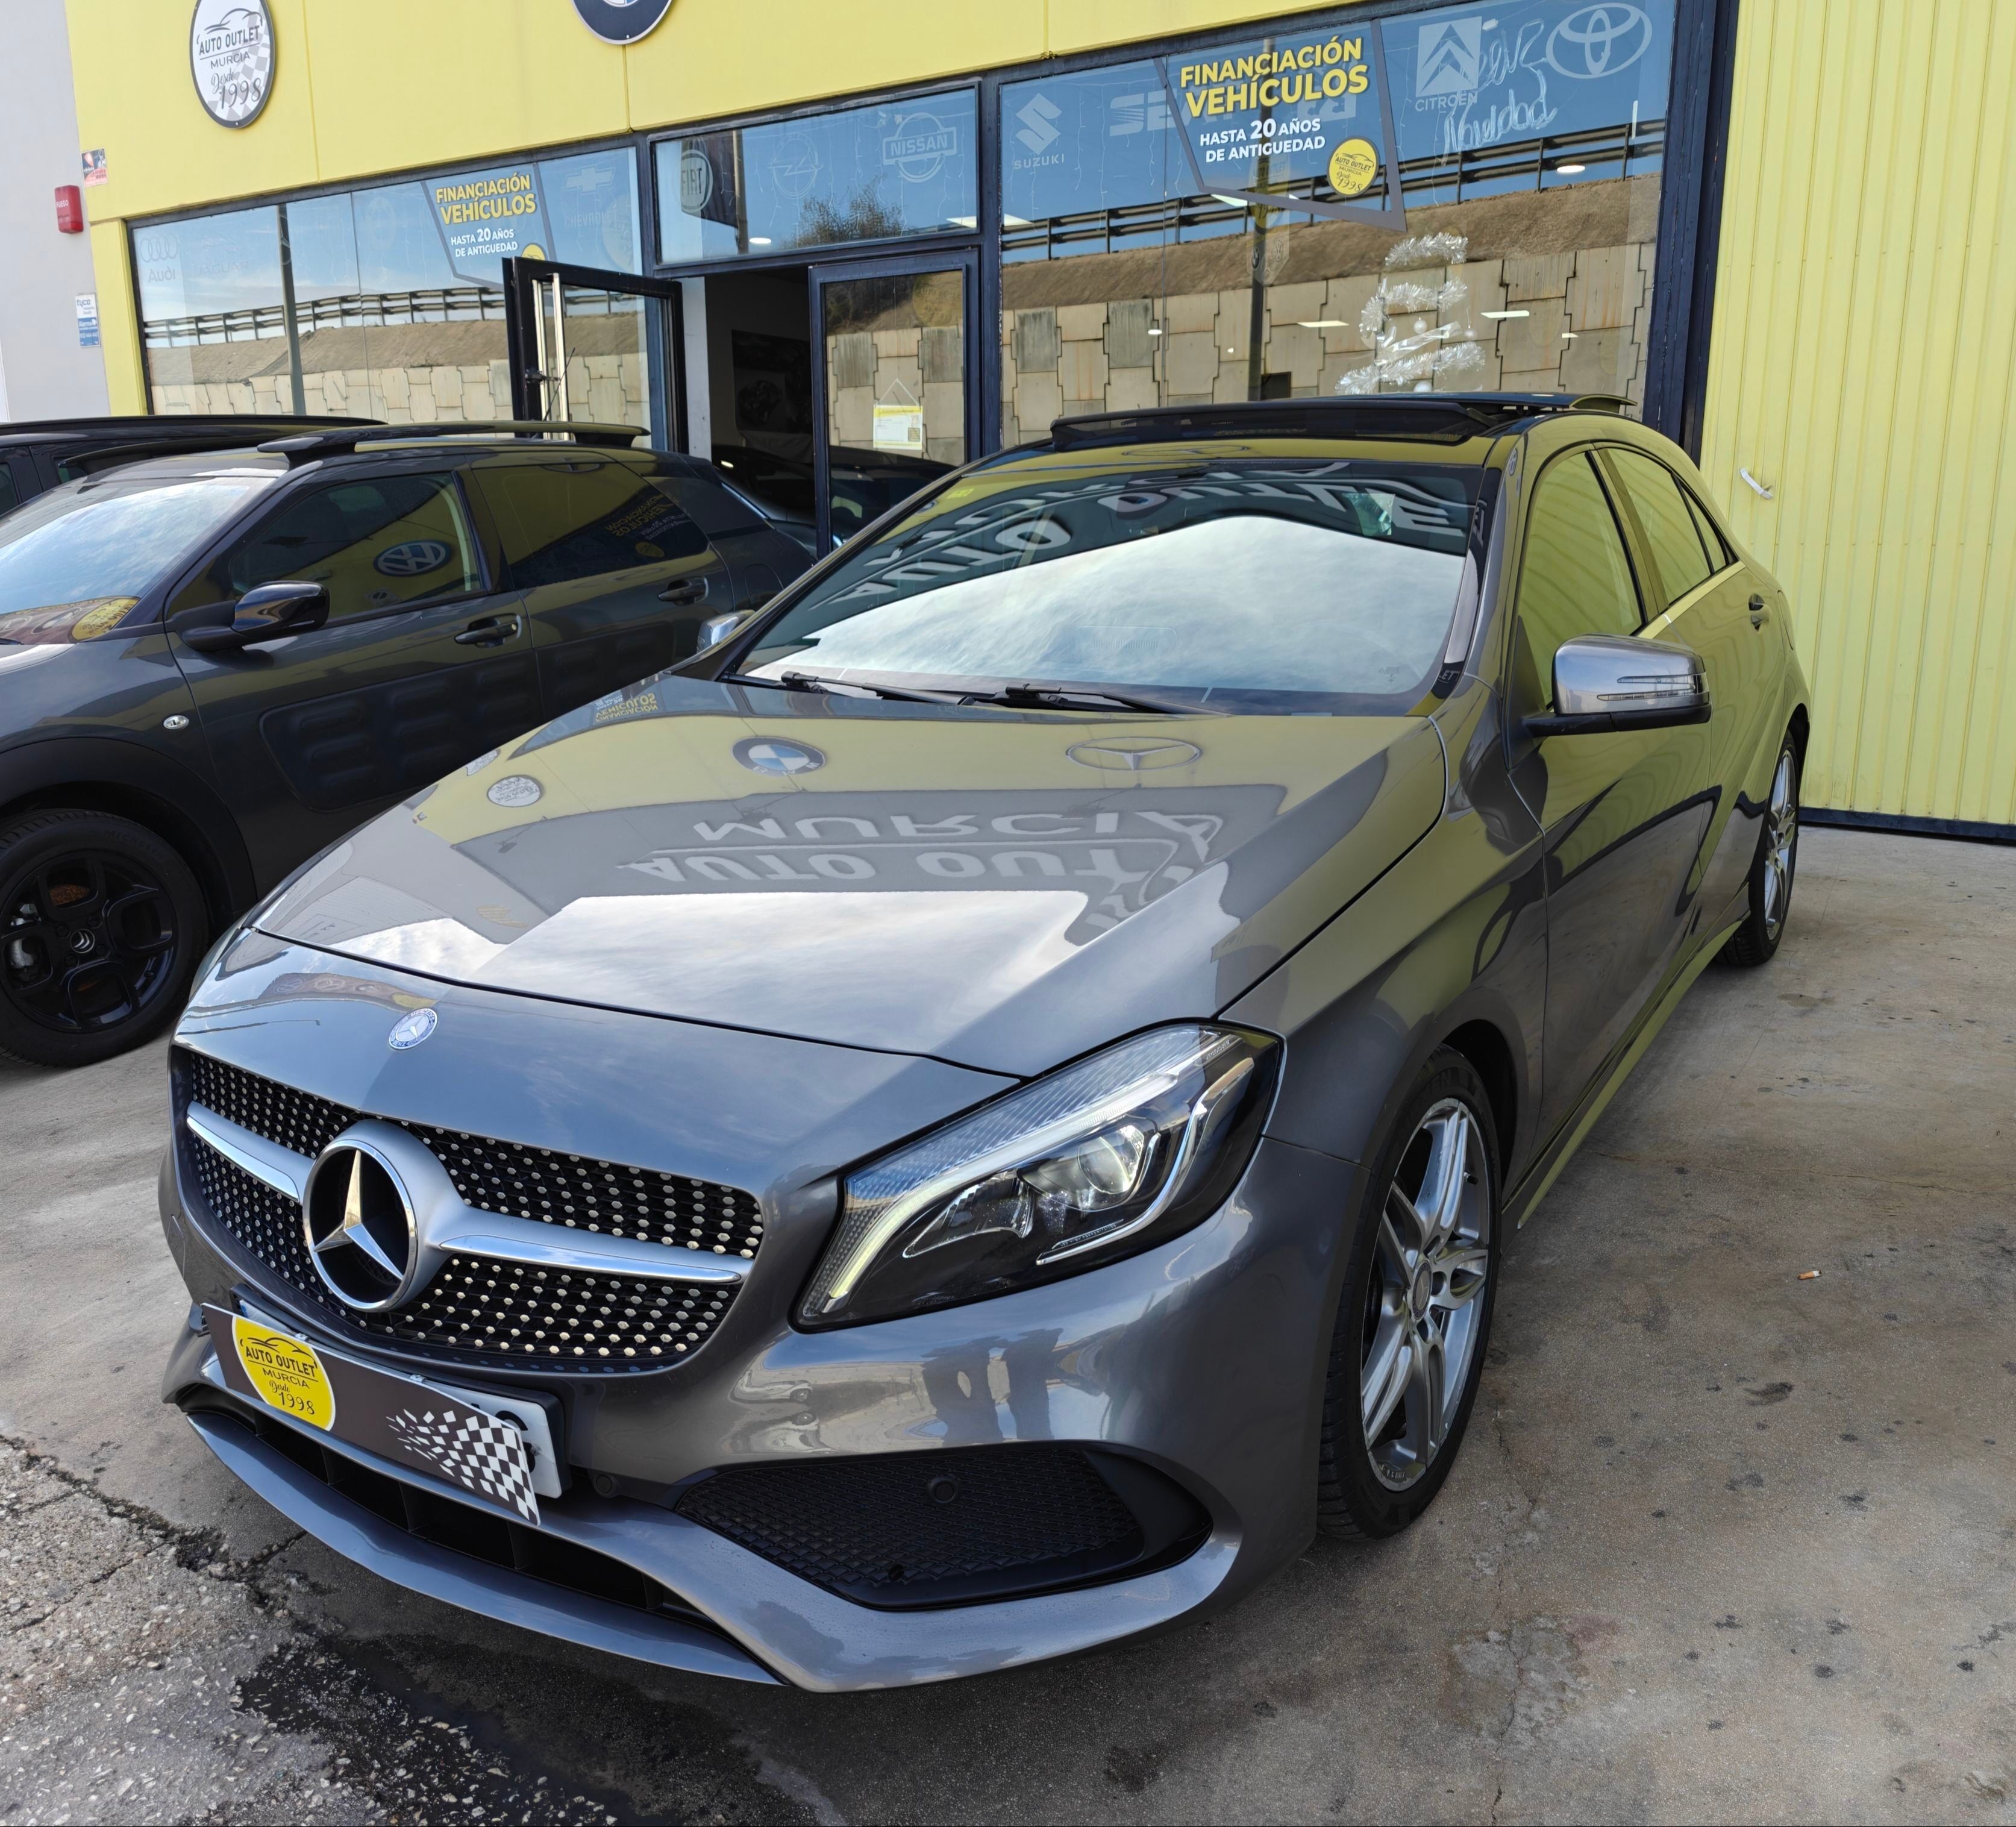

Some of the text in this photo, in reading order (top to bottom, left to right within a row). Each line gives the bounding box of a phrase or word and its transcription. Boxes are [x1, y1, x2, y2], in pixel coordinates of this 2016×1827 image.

[199, 25, 260, 55] AUTO OUTLET
[210, 51, 250, 69] MURCIA
[1180, 35, 1362, 88] FINANCIACIÓN
[211, 67, 235, 95] Desde
[1185, 64, 1369, 118] VEHÍCULOS
[219, 77, 261, 109] 1998
[1415, 90, 1478, 112] CITROËN
[1200, 118, 1321, 146] HASTA 20 AÑOS
[890, 134, 948, 156] NISSAN
[1206, 136, 1326, 163] DE ANTIGUEDAD
[1013, 154, 1065, 169] SUZUKI
[1335, 157, 1371, 171] AUTO OUTLET
[1339, 166, 1362, 176] MURCIA
[436, 172, 531, 203] FINANCIACIÓN
[681, 168, 702, 196] FIAT
[1338, 178, 1363, 192] 1998
[56, 199, 69, 208] FUEGO
[440, 193, 536, 225] VEHÍCULOS
[451, 227, 515, 245] HASTA 20 AÑOS
[455, 242, 518, 257] DE ANTIGUEDAD
[77, 299, 91, 308] tyco
[246, 1346, 315, 1377] AUTO OUTLET
[262, 1368, 310, 1389] MURCIA
[269, 1380, 290, 1393] Desde
[278, 1392, 315, 1415] 1998
